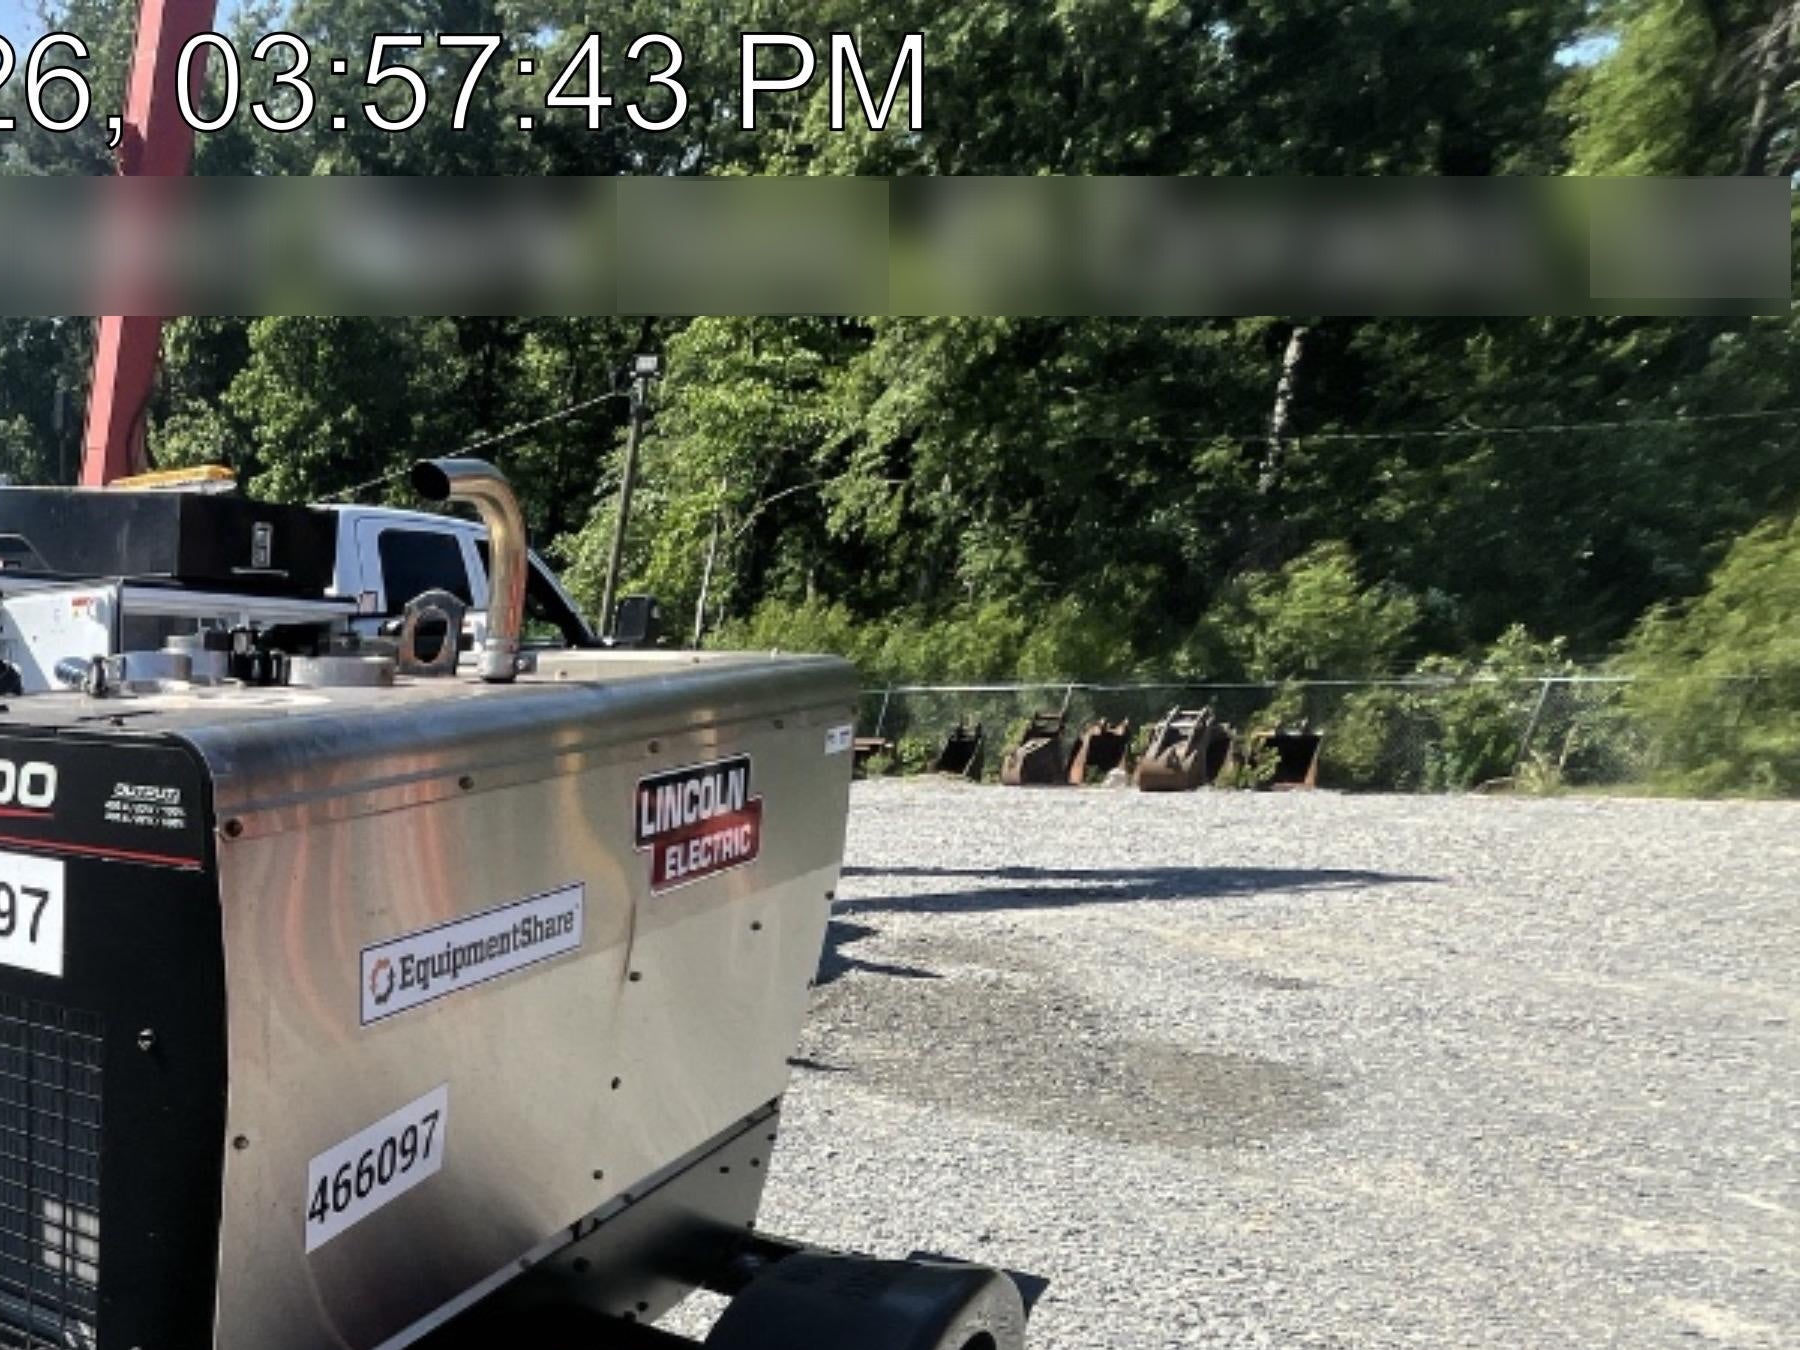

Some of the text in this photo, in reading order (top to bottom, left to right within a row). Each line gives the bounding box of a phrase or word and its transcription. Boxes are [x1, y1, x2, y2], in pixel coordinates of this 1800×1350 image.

[640, 767, 748, 836] LINCOLN
[663, 823, 751, 880] ELECTRIC
[399, 907, 575, 991] EquipmentShare
[307, 1109, 440, 1226] 466097
